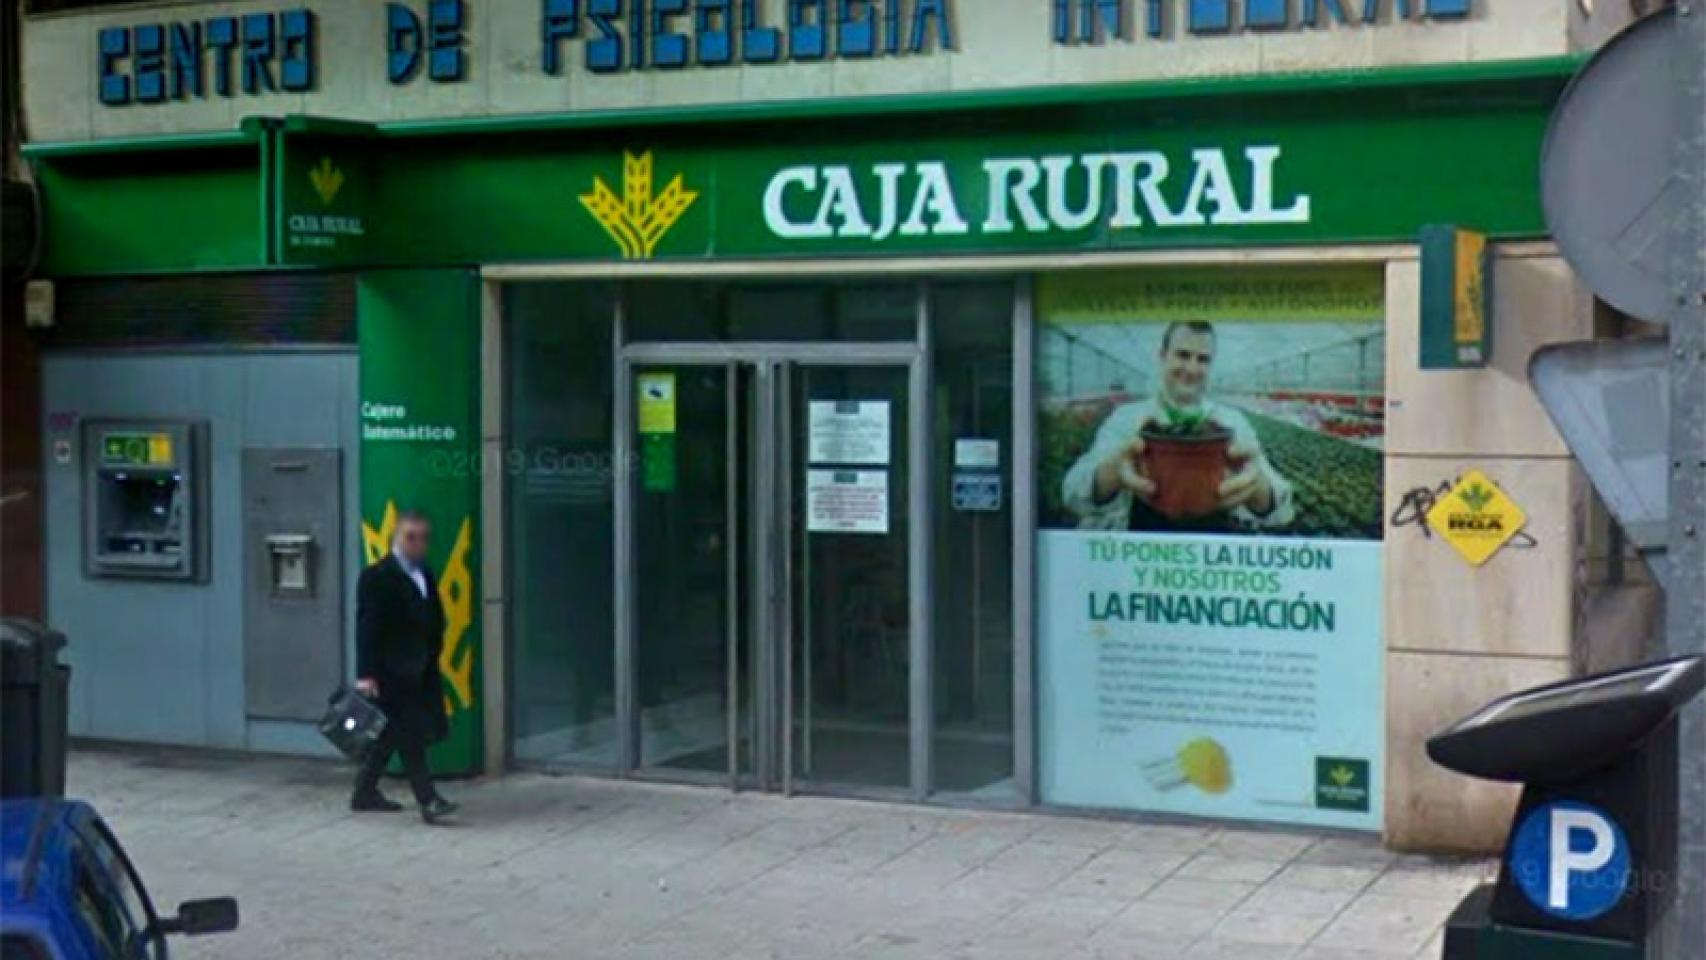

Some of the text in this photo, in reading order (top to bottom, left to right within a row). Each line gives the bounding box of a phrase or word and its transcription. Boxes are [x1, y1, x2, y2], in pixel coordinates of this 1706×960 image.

[99, 10, 315, 106] CENTRO
[387, 0, 465, 83] DE
[763, 145, 1311, 240] CAJA RURAL
[1089, 537, 1333, 570] TÚ PONES LA ILUSIÓN
[1133, 566, 1282, 593] Y NOSOTROS
[1089, 591, 1336, 632] LA FINANCIACIÓN
[1549, 807, 1616, 909] P
